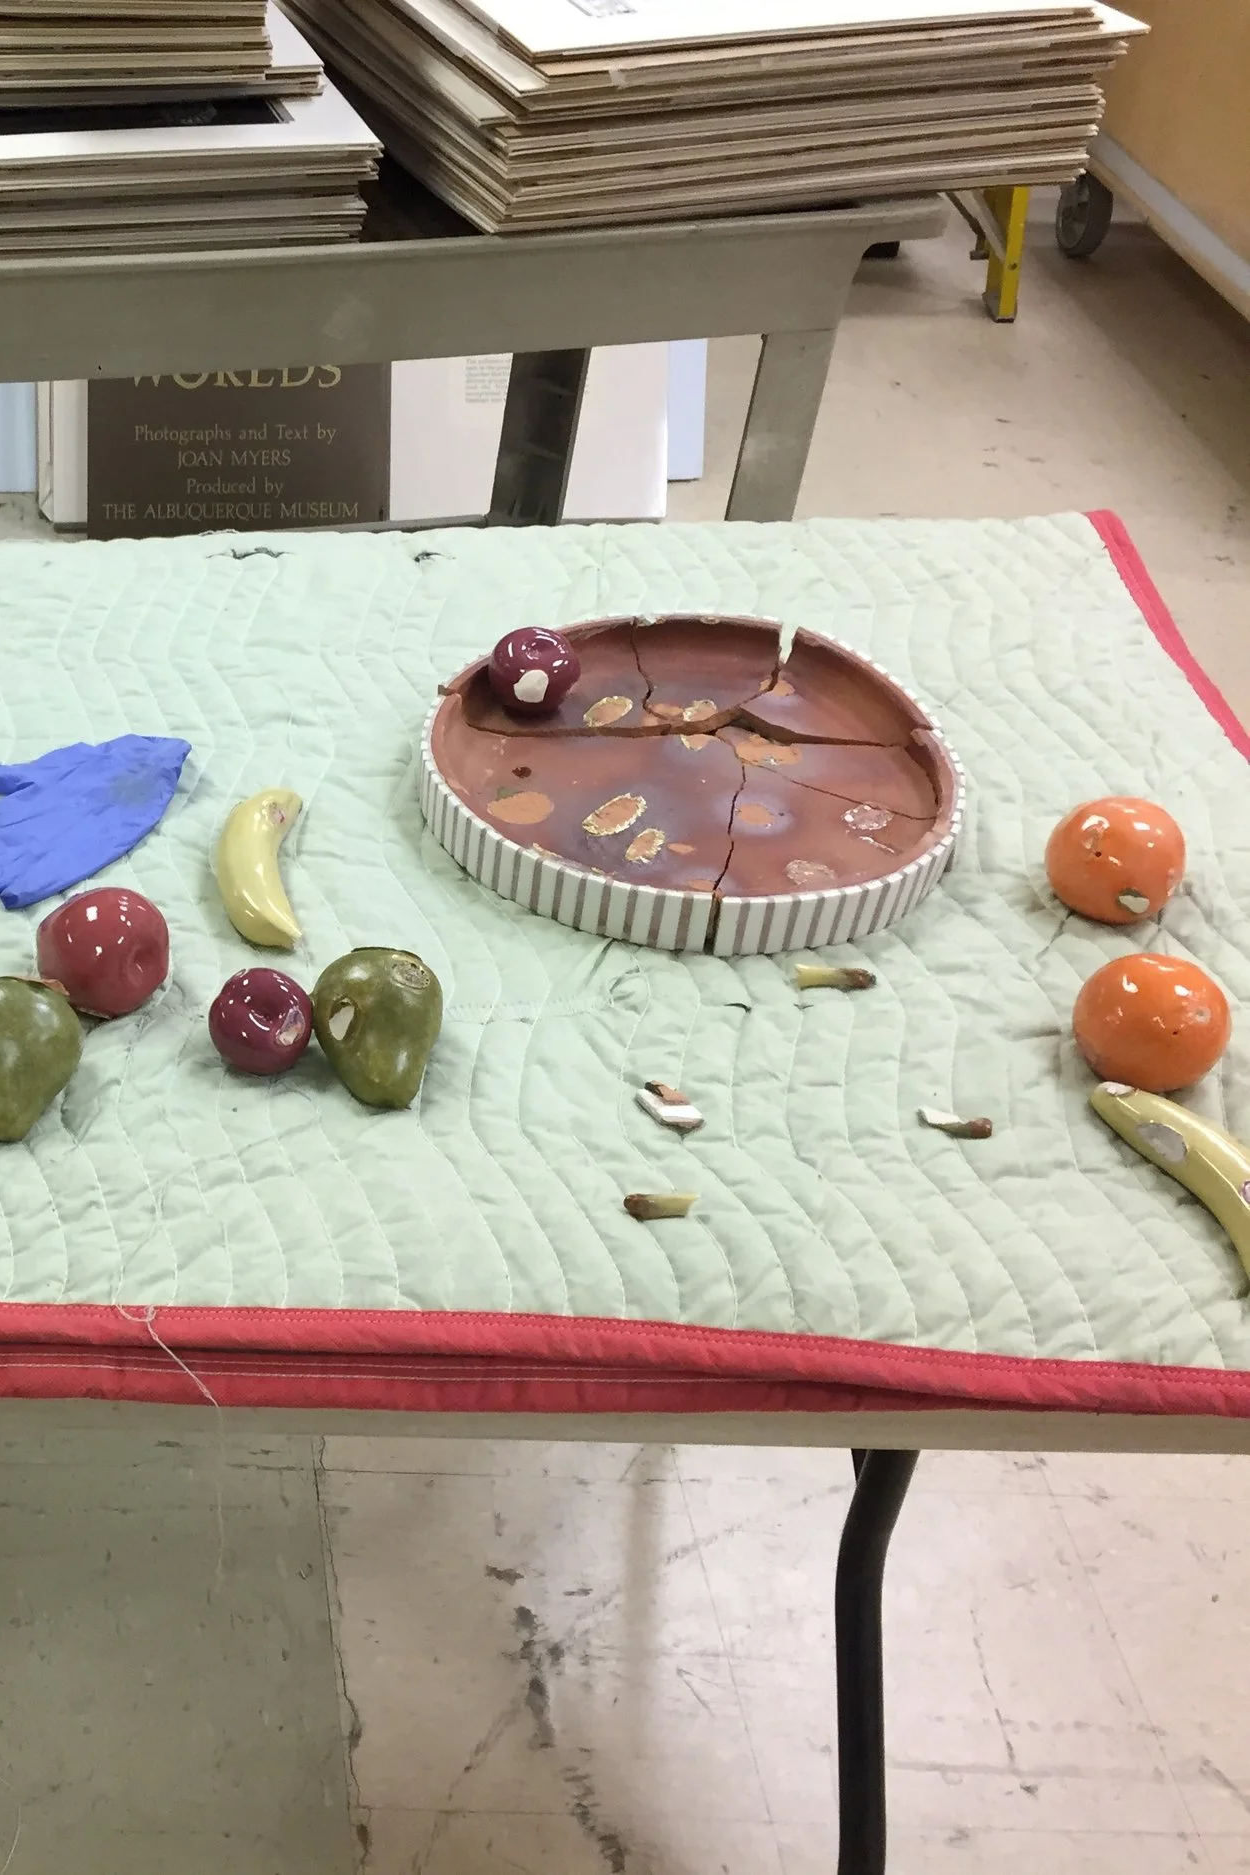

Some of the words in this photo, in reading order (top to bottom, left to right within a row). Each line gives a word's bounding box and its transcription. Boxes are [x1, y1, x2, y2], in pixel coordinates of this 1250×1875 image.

[134, 424, 232, 444] Photographs
[238, 424, 268, 441] and
[276, 424, 309, 440] Text
[316, 423, 337, 444] by
[177, 451, 223, 469] JOAN
[231, 450, 291, 467] MYERS
[186, 478, 257, 495] Produced
[264, 477, 284, 498] by
[102, 503, 137, 520] THE
[144, 503, 273, 522] ALBUQUERQUE
[279, 502, 359, 519] MUSEUM
